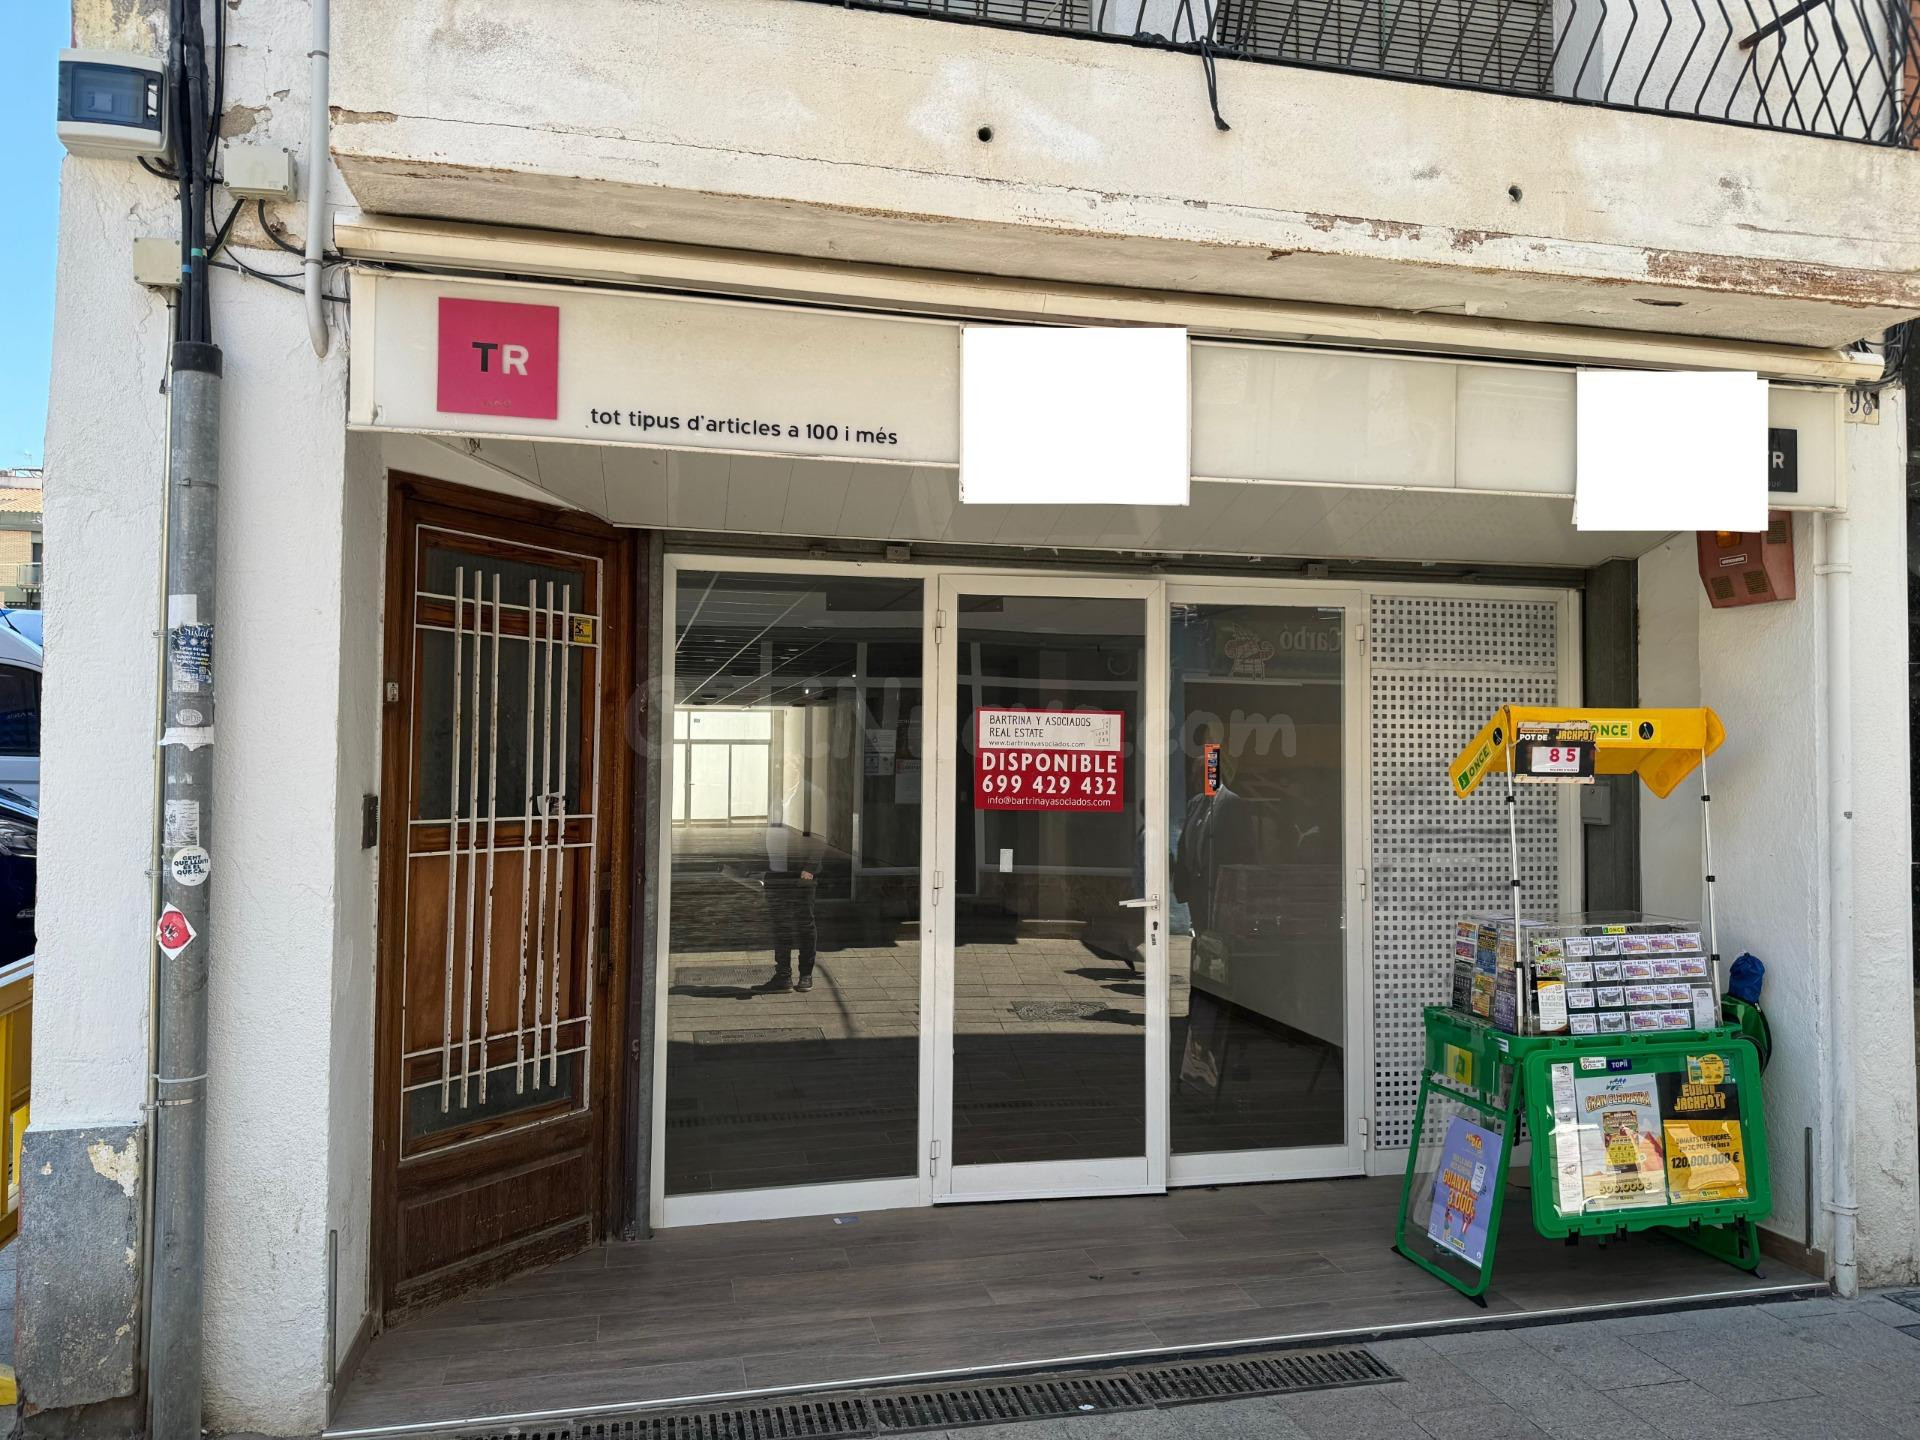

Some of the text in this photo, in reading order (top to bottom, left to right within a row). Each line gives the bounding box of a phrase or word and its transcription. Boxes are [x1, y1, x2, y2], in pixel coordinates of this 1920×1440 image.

[471, 341, 529, 376] TR
[1850, 390, 1873, 416] 98
[590, 408, 898, 445] tot tipus d'articles a 100 i més
[989, 714, 1091, 727] BARTRINA Y ASOCIADOS
[989, 727, 1044, 737] REAL ESTATE
[1519, 733, 1536, 741] POT
[988, 739, 1086, 748] www.bartrinayasociados.com
[982, 752, 1117, 773] DISPONIBLE
[1468, 750, 1489, 777] ONCE
[982, 774, 1116, 795] 699 429 432
[987, 796, 1111, 806] info@bartrinayasociados.com
[1671, 1152, 1740, 1168] 120.000.000 €
